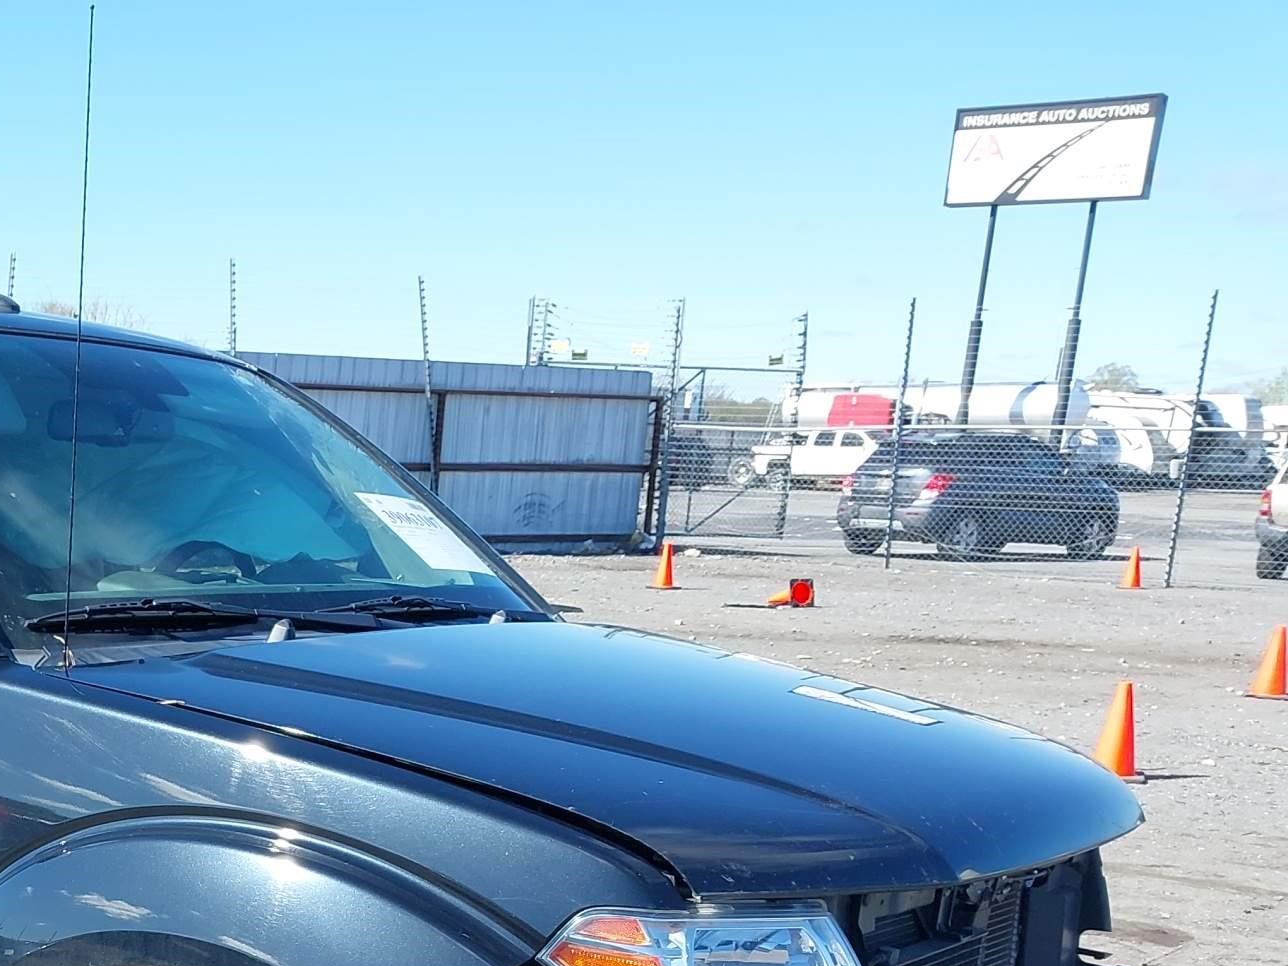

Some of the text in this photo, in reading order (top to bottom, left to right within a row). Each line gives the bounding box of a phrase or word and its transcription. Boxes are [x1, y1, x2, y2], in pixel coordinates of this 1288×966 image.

[963, 103, 1150, 127] INSURANCE AUTO AUCTIONS
